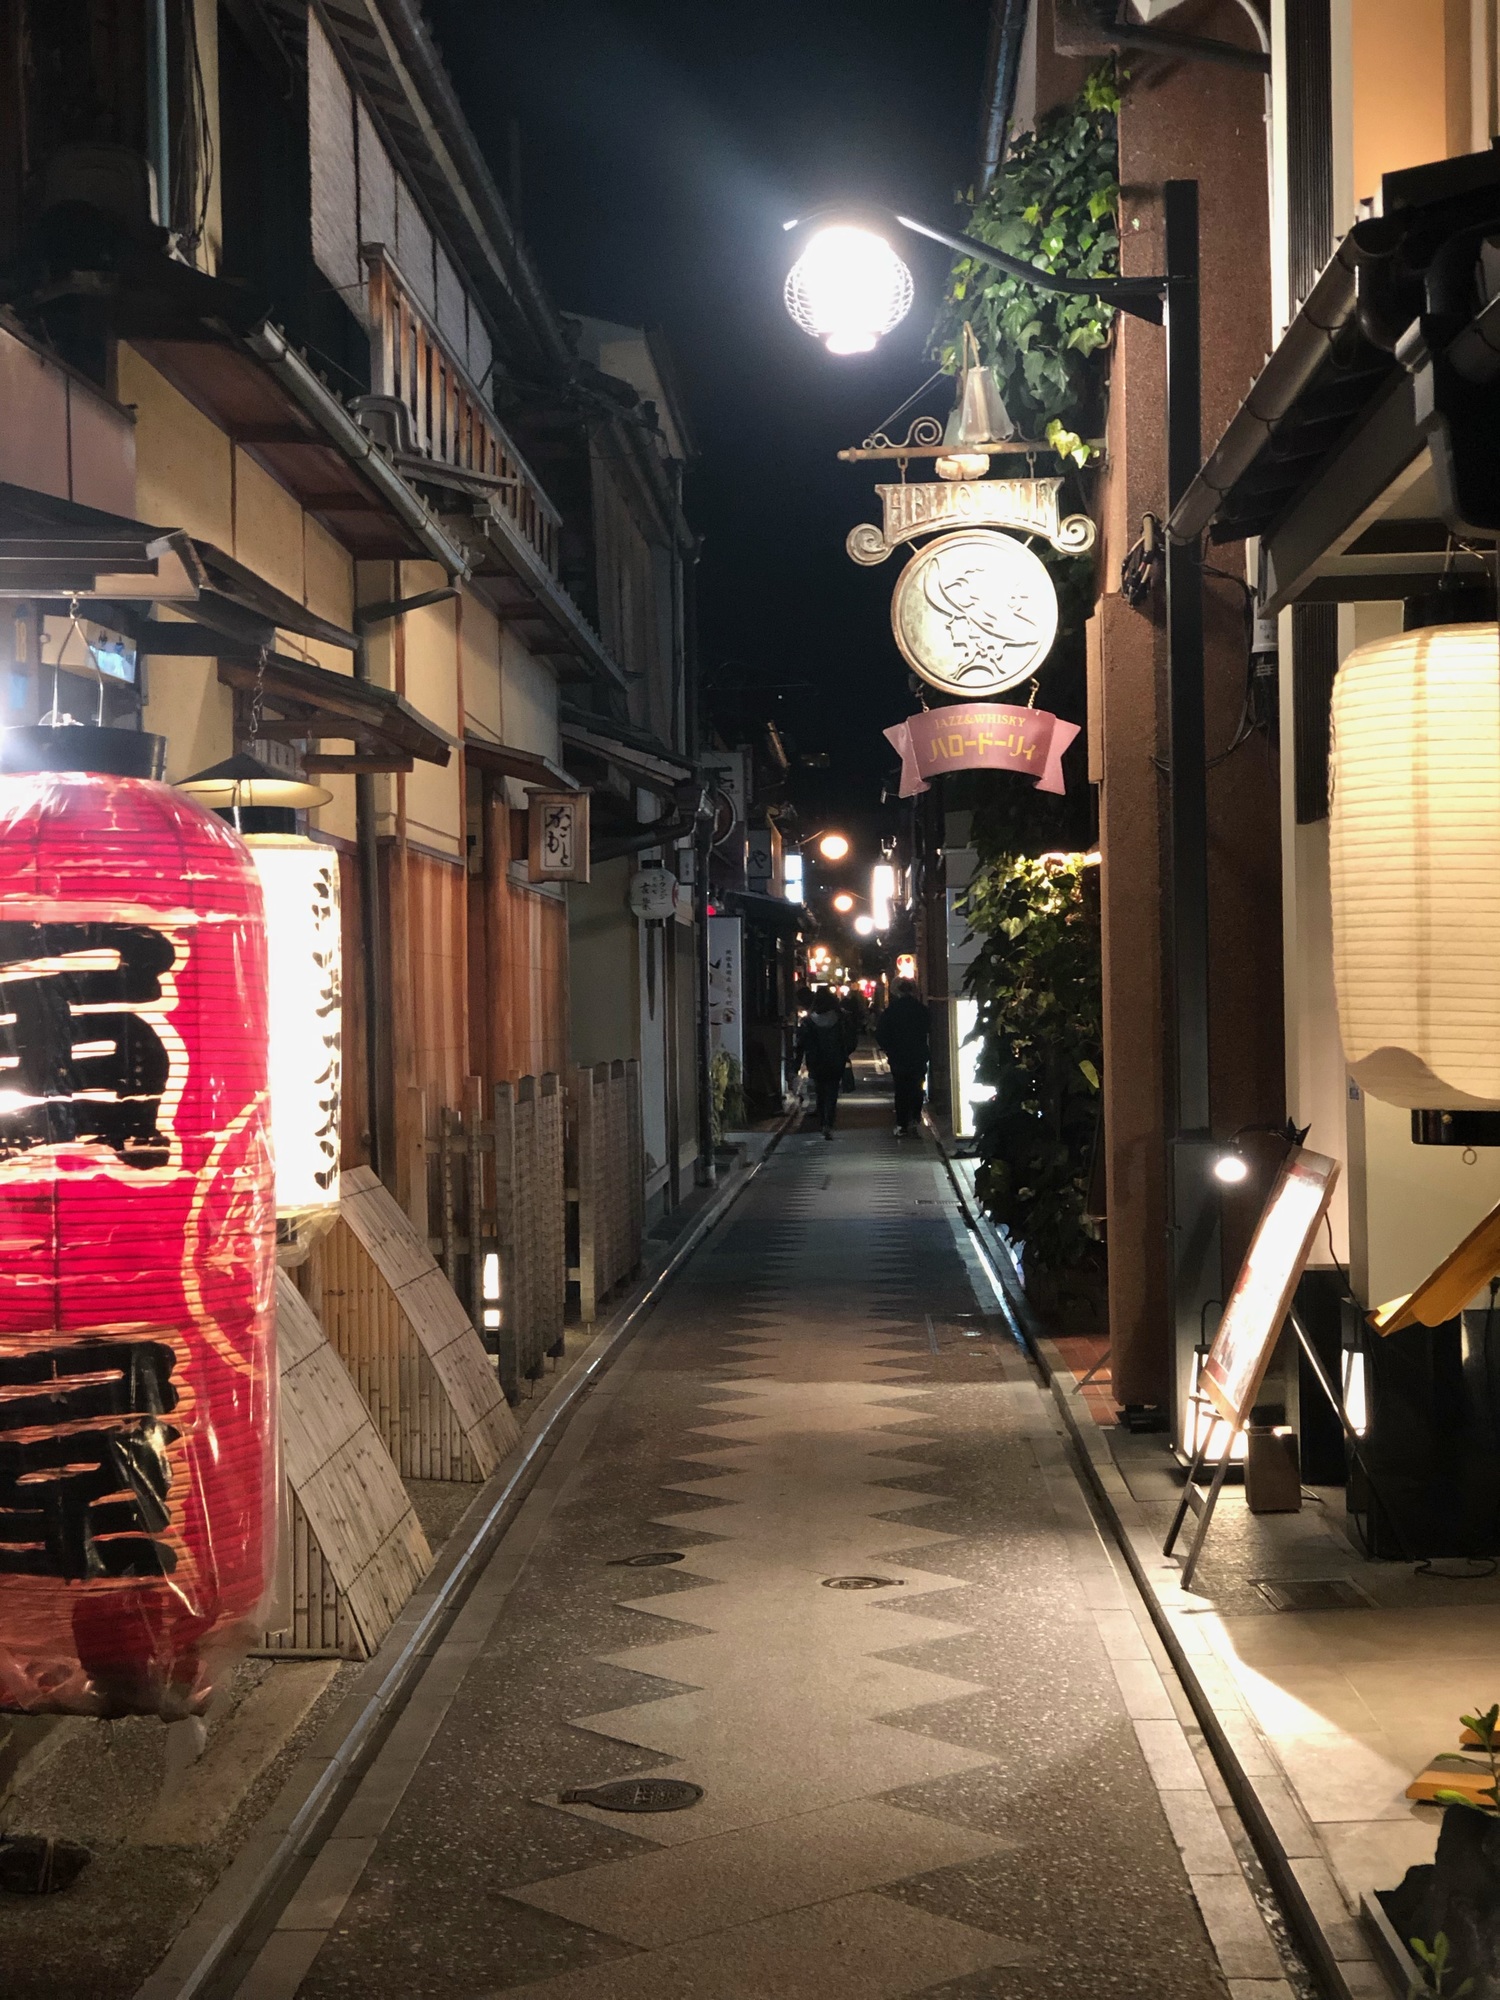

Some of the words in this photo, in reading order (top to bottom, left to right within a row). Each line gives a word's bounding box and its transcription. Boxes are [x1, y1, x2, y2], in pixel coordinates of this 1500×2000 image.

[934, 713, 1027, 729] JAZZ&WHISKY
[928, 732, 1037, 763] ハロードーリィ
